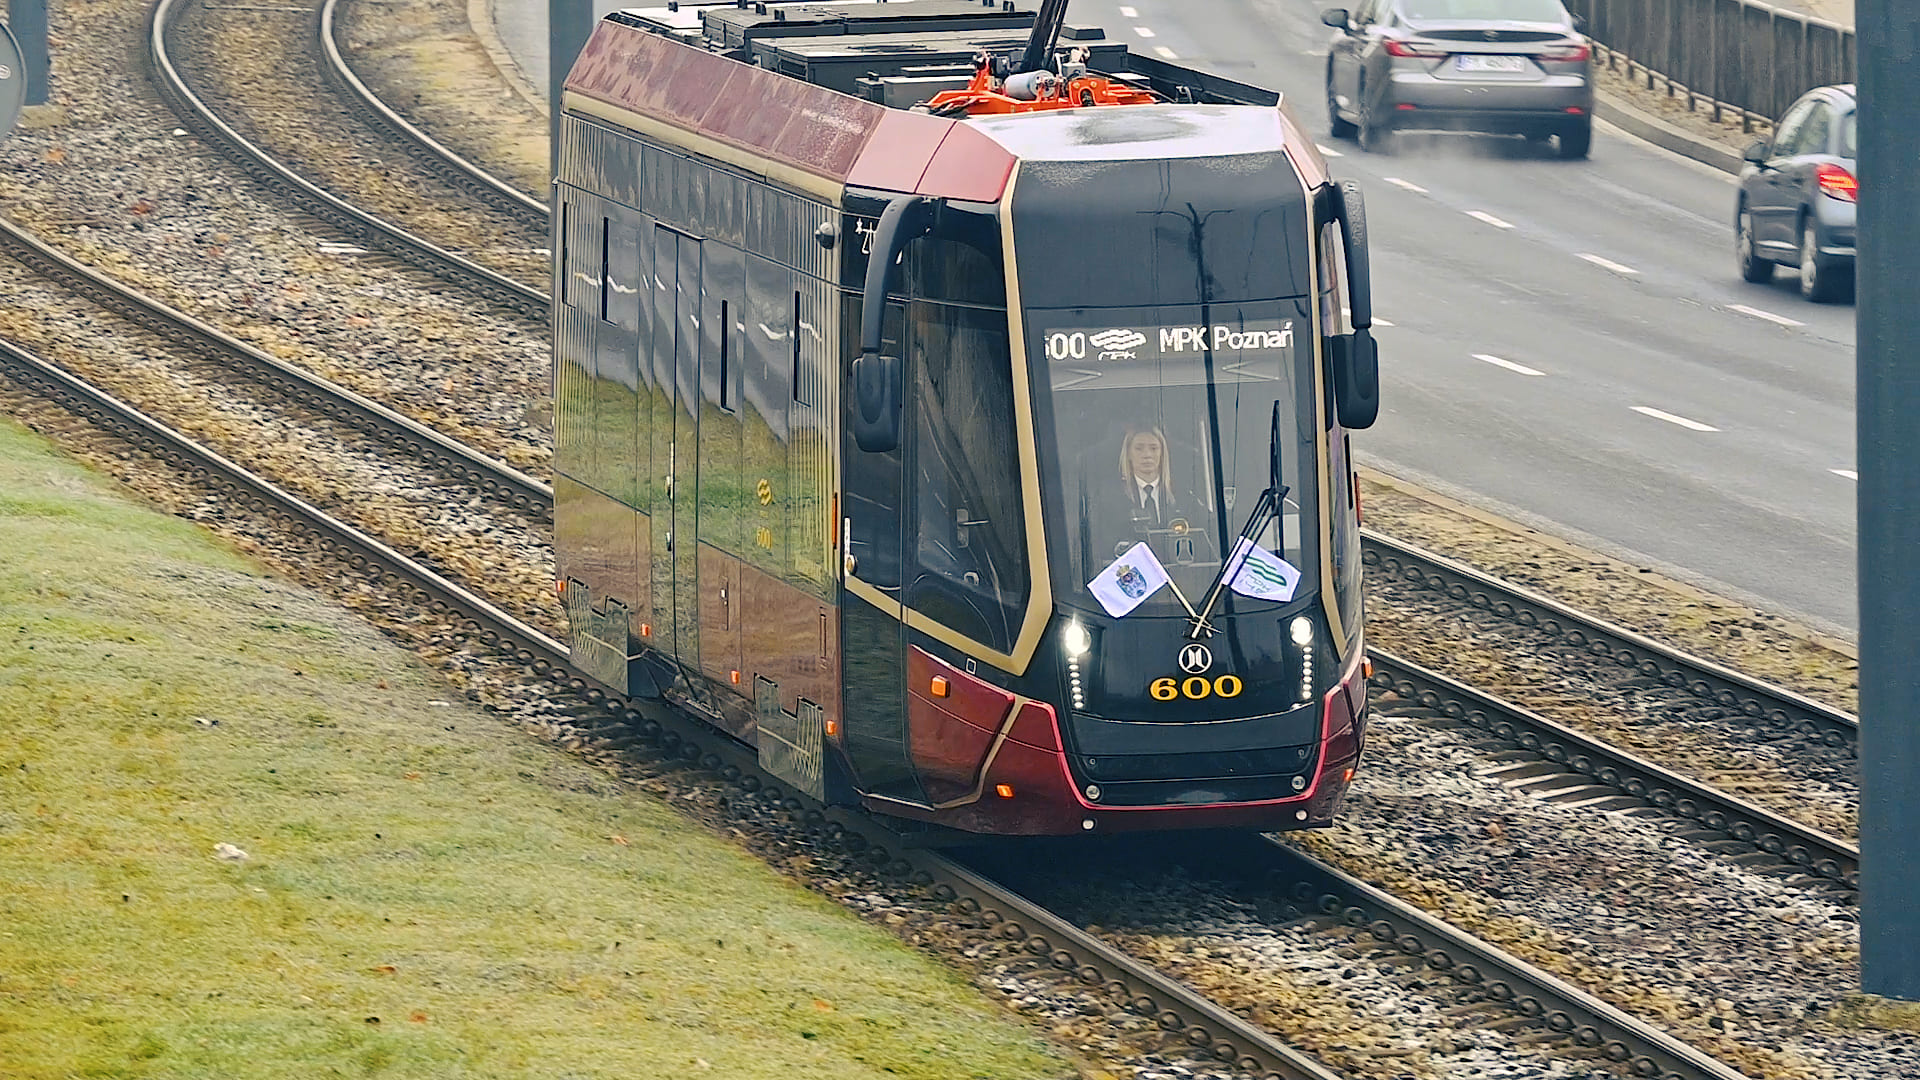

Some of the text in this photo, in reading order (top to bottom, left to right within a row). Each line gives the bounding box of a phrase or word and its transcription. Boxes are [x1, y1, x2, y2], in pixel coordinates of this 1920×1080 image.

[1159, 326, 1209, 353] MPK
[1213, 321, 1293, 351] Poznań
[1149, 674, 1243, 701] 600
